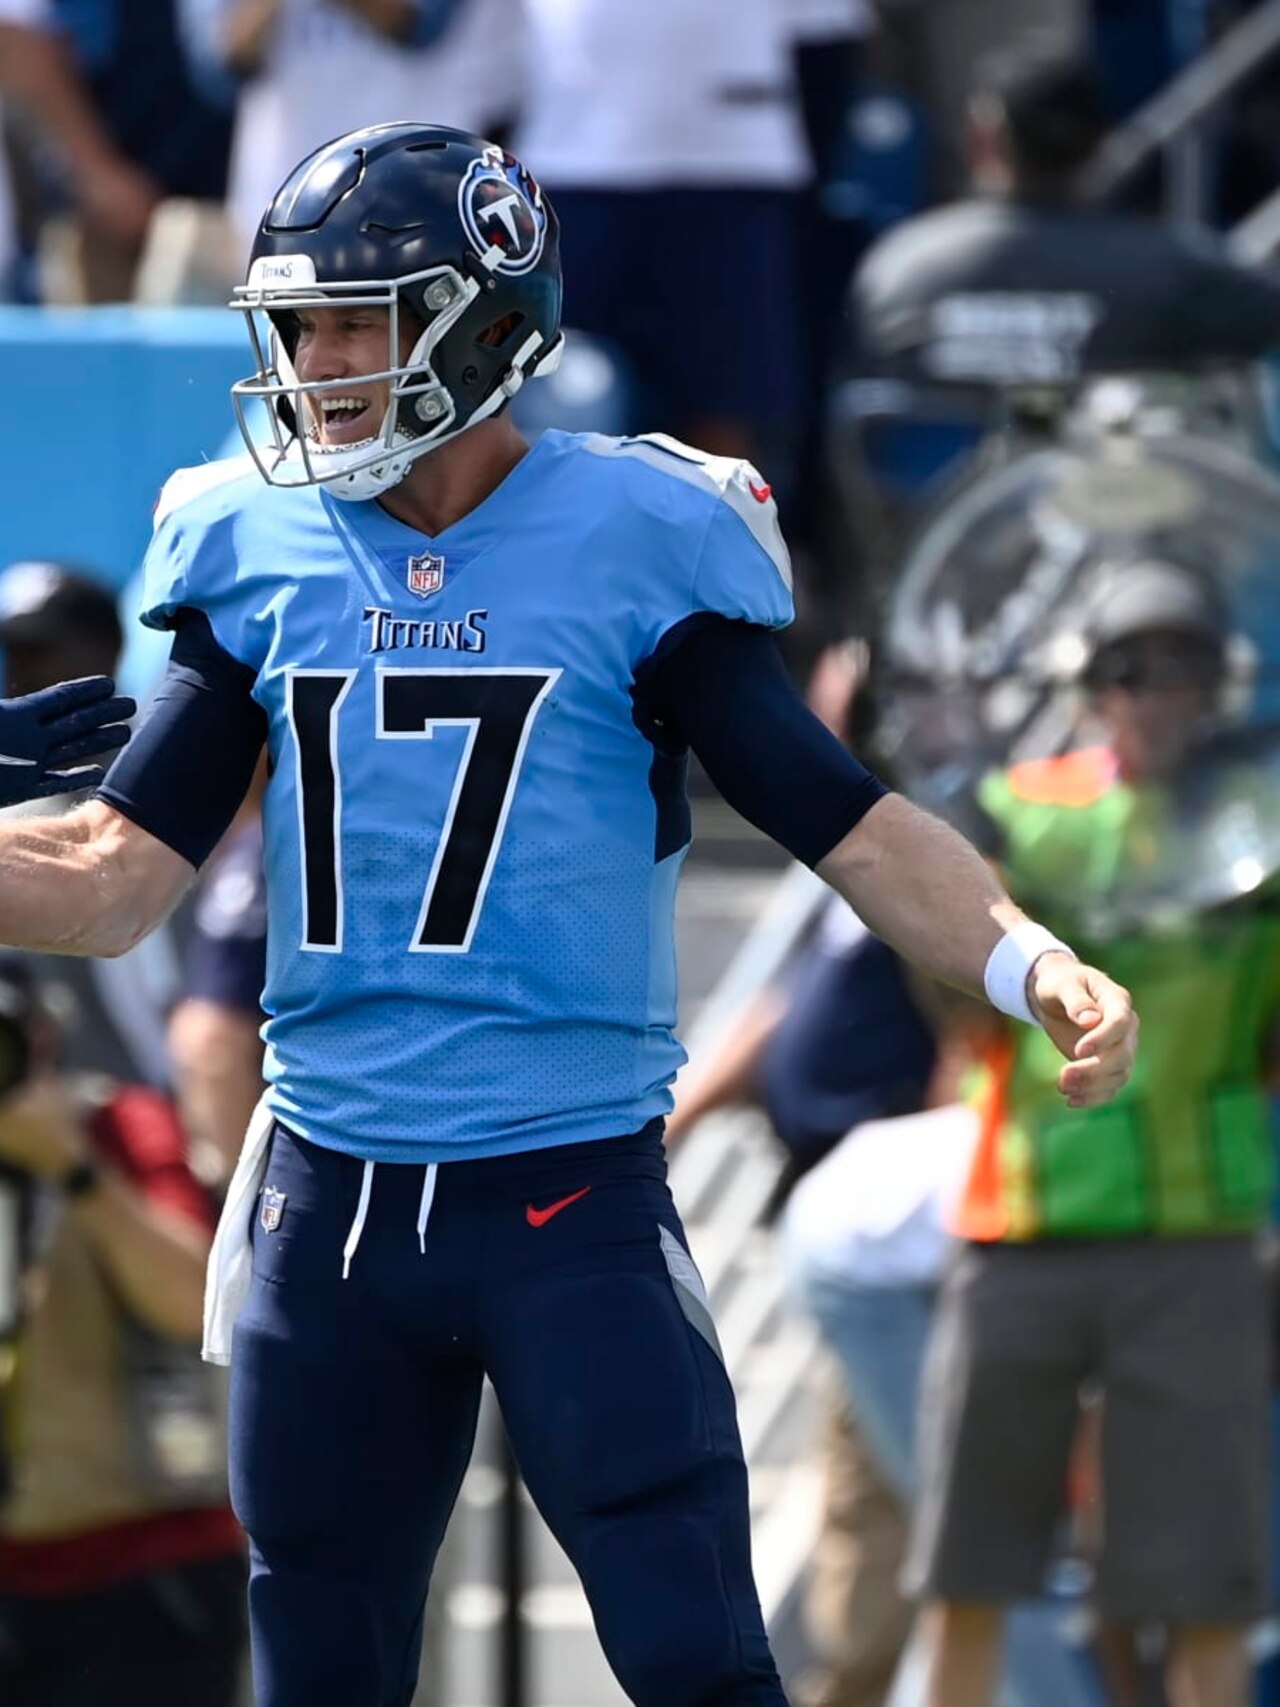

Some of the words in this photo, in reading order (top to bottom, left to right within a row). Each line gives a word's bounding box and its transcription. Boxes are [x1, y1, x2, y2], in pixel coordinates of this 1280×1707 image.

[261, 262, 293, 279] TITANS
[413, 571, 439, 589] NFL
[363, 606, 488, 654] TITANS
[285, 667, 564, 953] 17
